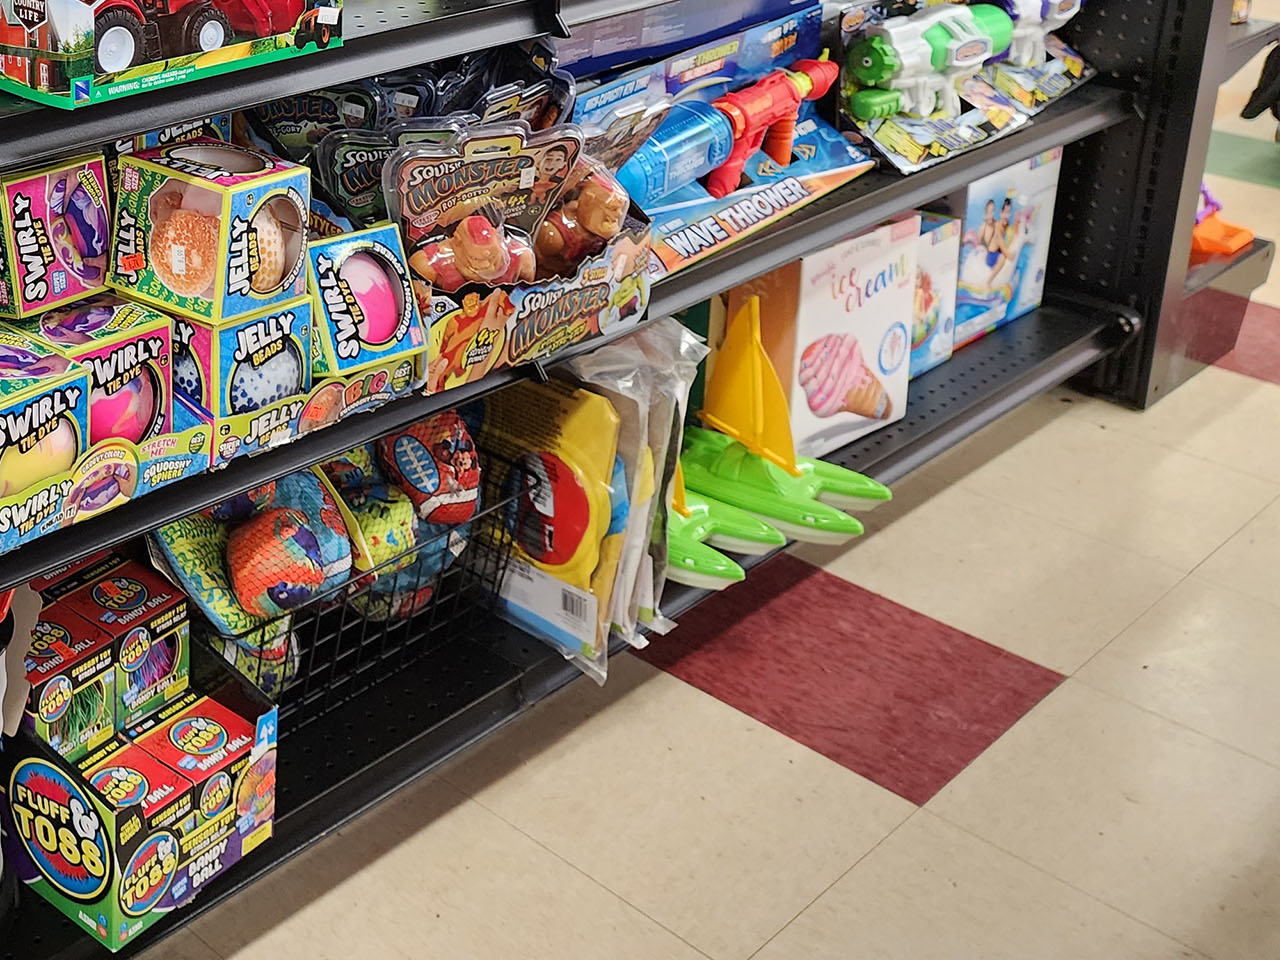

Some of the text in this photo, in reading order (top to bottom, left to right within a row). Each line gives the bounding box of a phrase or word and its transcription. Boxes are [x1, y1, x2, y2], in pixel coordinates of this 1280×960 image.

[19, 9, 41, 23] LIFE
[108, 81, 140, 96] WARNING:
[408, 157, 532, 213] MONSTER
[410, 160, 462, 185] SQUISH
[664, 177, 812, 258] WAVE THROWER
[15, 195, 47, 301] SWIRLY
[228, 216, 250, 295] JELLY
[249, 232, 259, 272] BEADS
[318, 255, 360, 359] SWIRLY
[510, 285, 609, 355] MONSTER
[519, 289, 564, 318] SQUISH
[234, 312, 295, 361] JELLY
[253, 340, 283, 365] BEADS
[107, 365, 142, 395] TIE DYE
[345, 370, 387, 405] BIG
[20, 417, 59, 453] TIE DYE
[246, 401, 303, 446] JELLY
[140, 438, 177, 454] STRETCH
[149, 448, 167, 458] ME!
[142, 459, 192, 485] SQUOOSHY
[151, 469, 186, 488] SPHERE
[19, 502, 56, 535] TIE DYE
[41, 504, 76, 533] KNEAD IT!
[16, 784, 99, 839] FLUFF &
[13, 803, 105, 877] TOSS
[122, 854, 176, 908] TOSS
[125, 852, 158, 889] FLUFF
